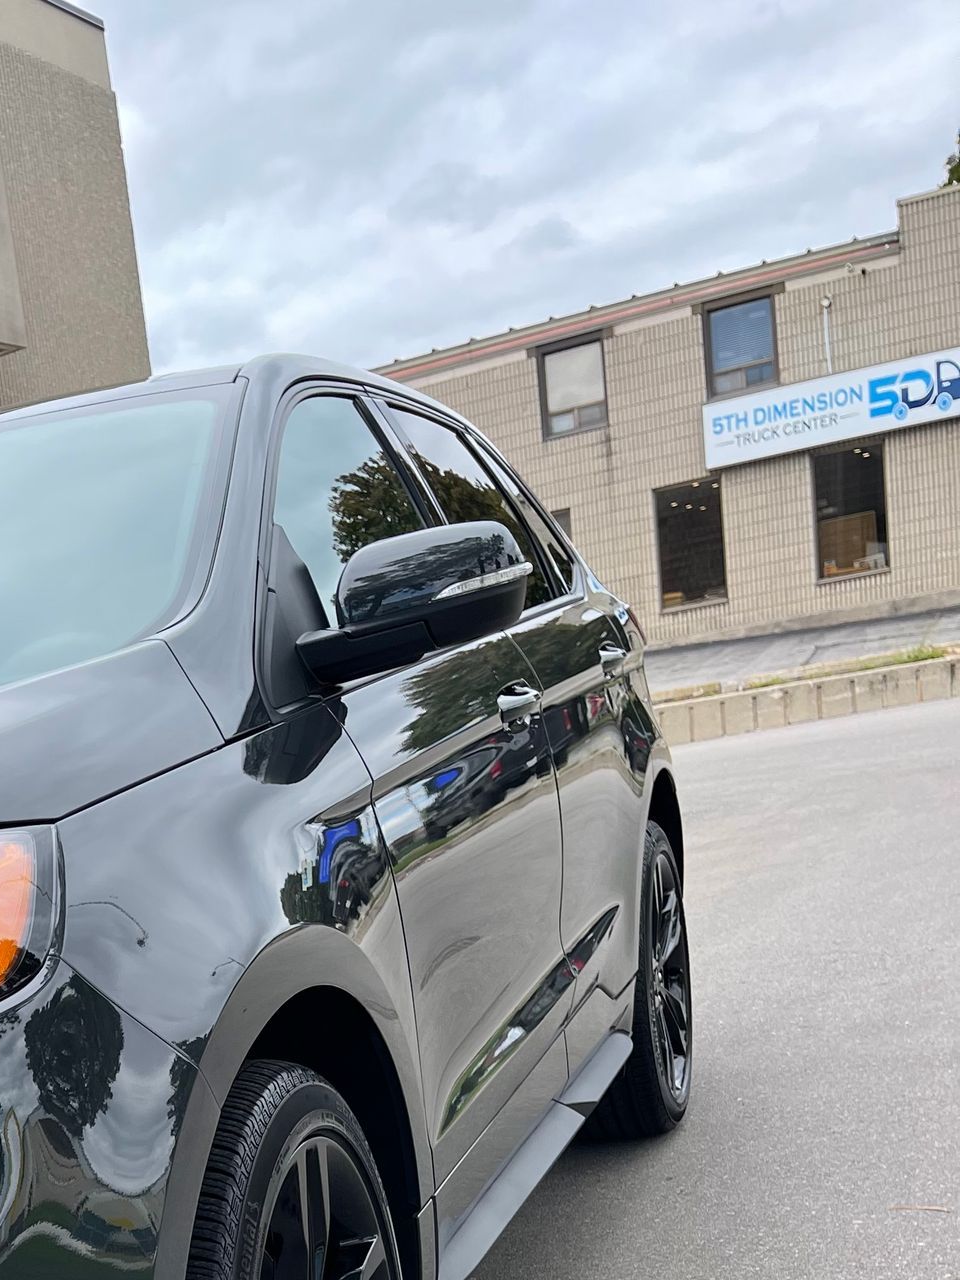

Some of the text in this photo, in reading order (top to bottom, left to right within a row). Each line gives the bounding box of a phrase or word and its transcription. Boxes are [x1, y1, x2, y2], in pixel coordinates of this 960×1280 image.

[712, 384, 863, 435] 5TH DIMENSION
[734, 413, 839, 447] TRUCK CENTER
